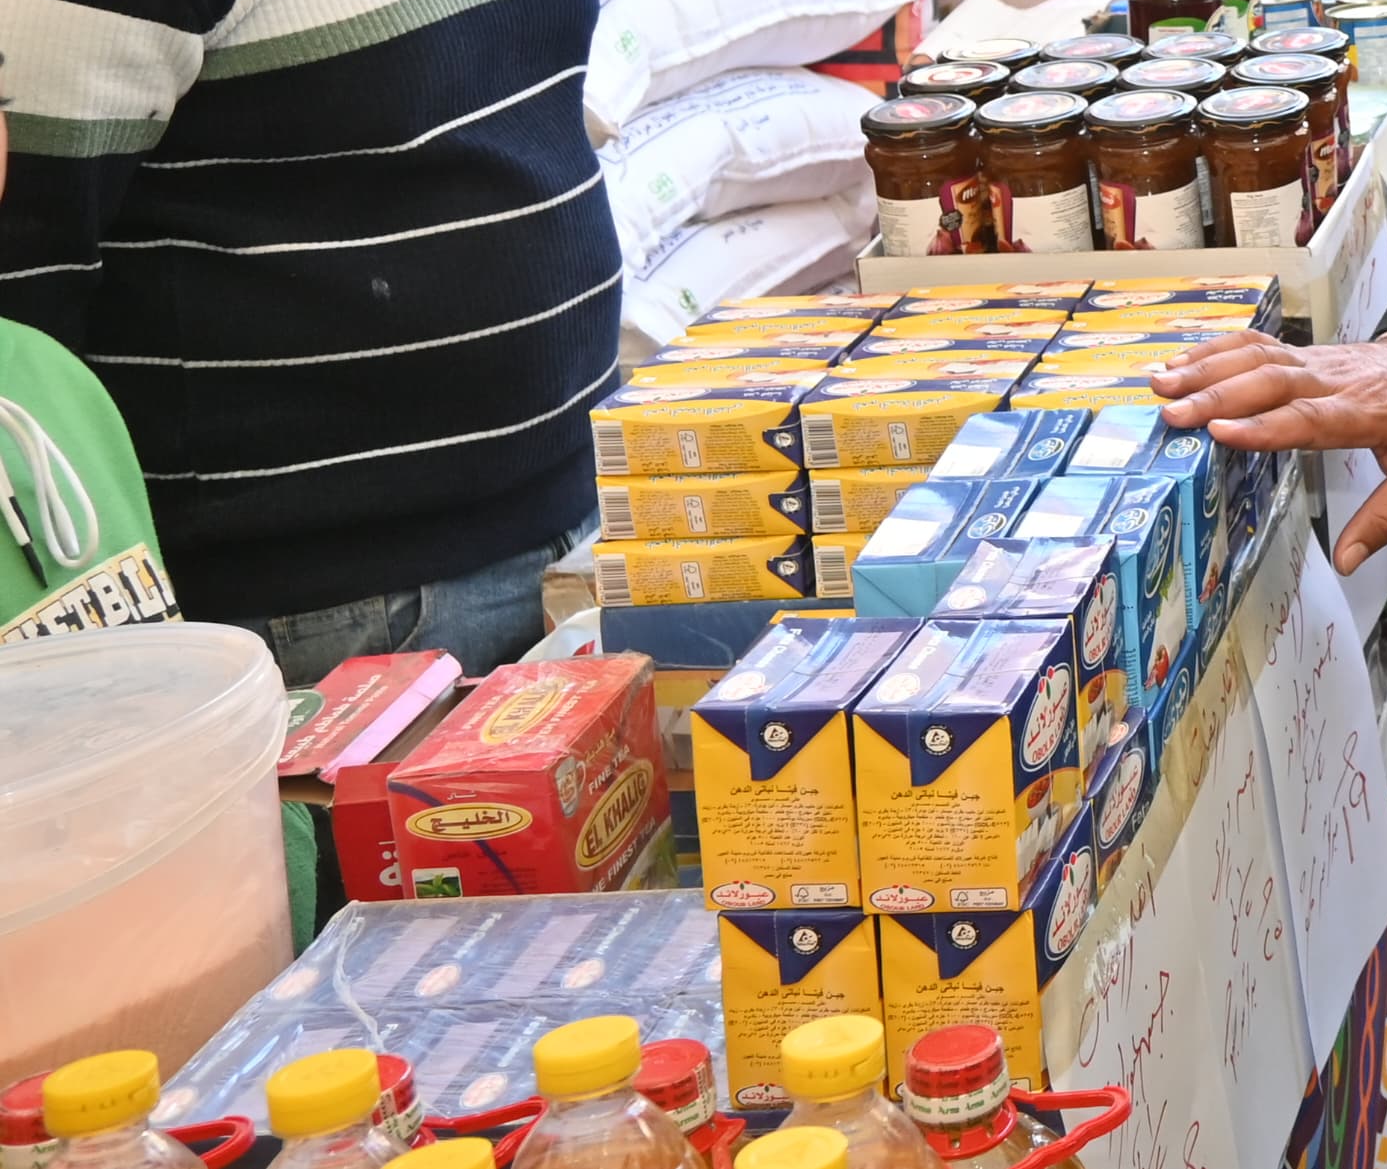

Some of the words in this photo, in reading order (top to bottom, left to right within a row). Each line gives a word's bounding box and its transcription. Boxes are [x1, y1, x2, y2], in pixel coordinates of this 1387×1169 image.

[588, 765, 612, 795] FINE
[611, 744, 631, 769] TEA
[429, 809, 511, 833] الخليج
[586, 831, 603, 858] EL
[602, 776, 648, 836] KHALIG
[607, 841, 638, 882] FINEST
